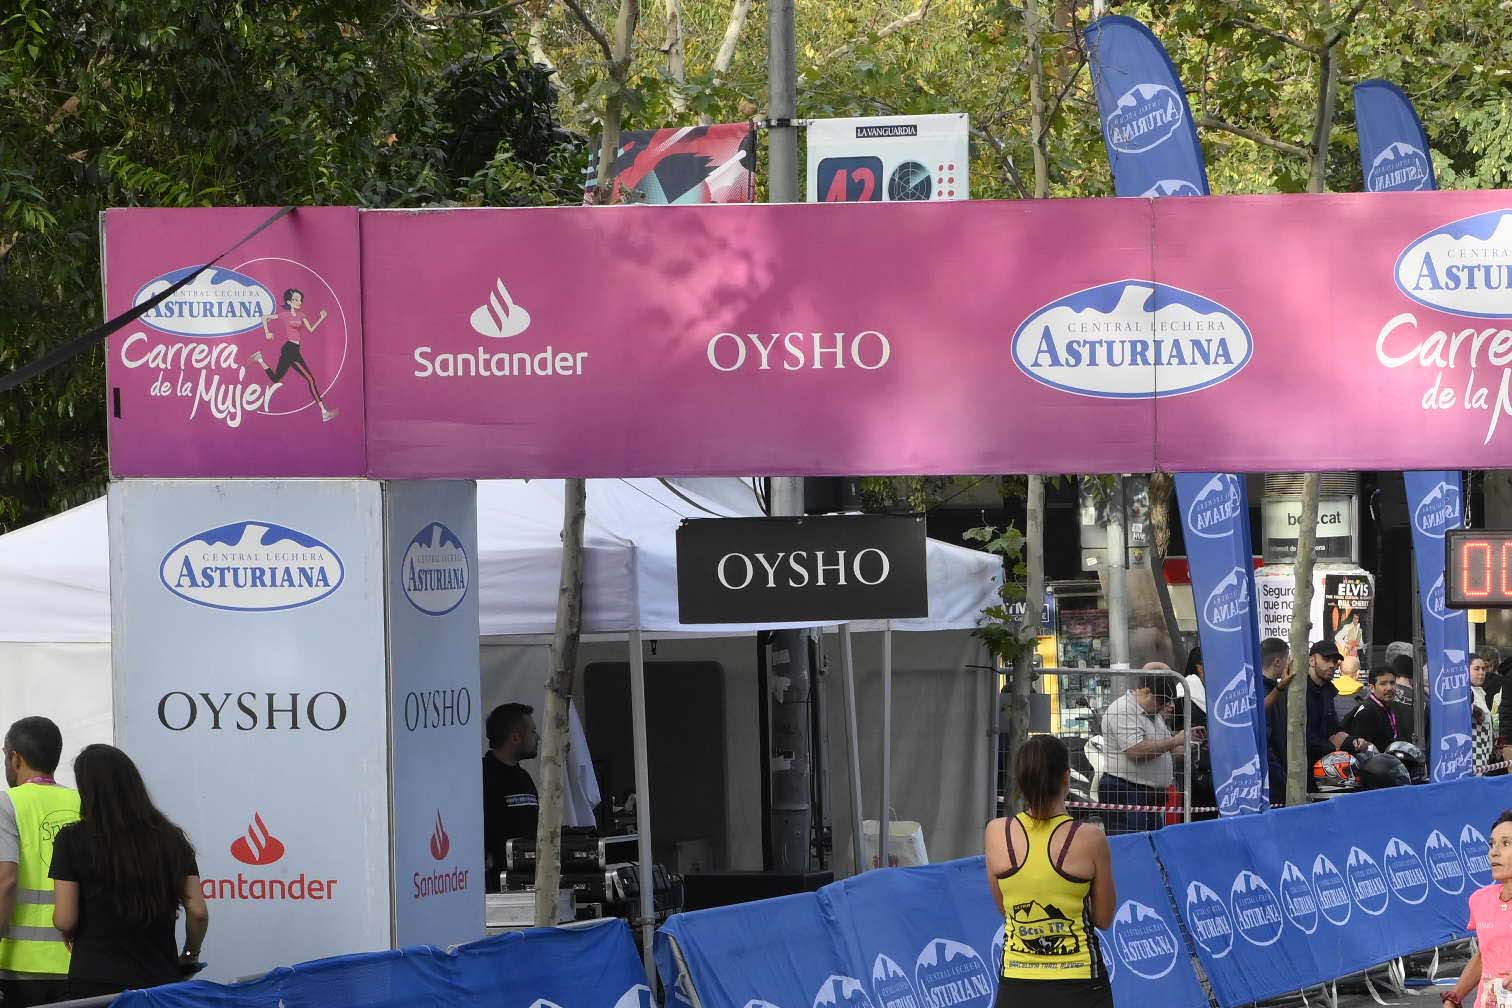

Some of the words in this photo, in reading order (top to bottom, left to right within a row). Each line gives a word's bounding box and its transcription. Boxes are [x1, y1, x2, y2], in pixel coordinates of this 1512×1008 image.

[857, 127, 869, 137] LA
[866, 126, 917, 137] VANGUARDIA
[143, 292, 264, 319] ASTURIANA
[1067, 320, 1143, 333] CENTRAL
[1150, 319, 1227, 332] LECHERA
[120, 331, 239, 370] Carrera
[414, 345, 588, 377] Santander
[706, 329, 891, 373] OYSHO
[1031, 323, 1234, 368] ASTURIANA
[150, 371, 172, 396] de
[177, 370, 193, 396] la
[189, 367, 283, 428] Mujer
[1421, 372, 1457, 411] de
[1464, 368, 1489, 410] la
[175, 554, 331, 589] ASTURIANA
[202, 552, 261, 562] CENTRAL
[266, 552, 325, 562] LECHERA
[716, 546, 891, 590] OYSHO
[407, 559, 465, 594] ASTURIANA
[1337, 583, 1369, 596] ELVIS
[1263, 600, 1280, 611] que
[157, 690, 347, 732] OYSHO
[404, 686, 471, 732] OYSHO
[201, 872, 338, 901] antander
[413, 867, 469, 900] Santander
